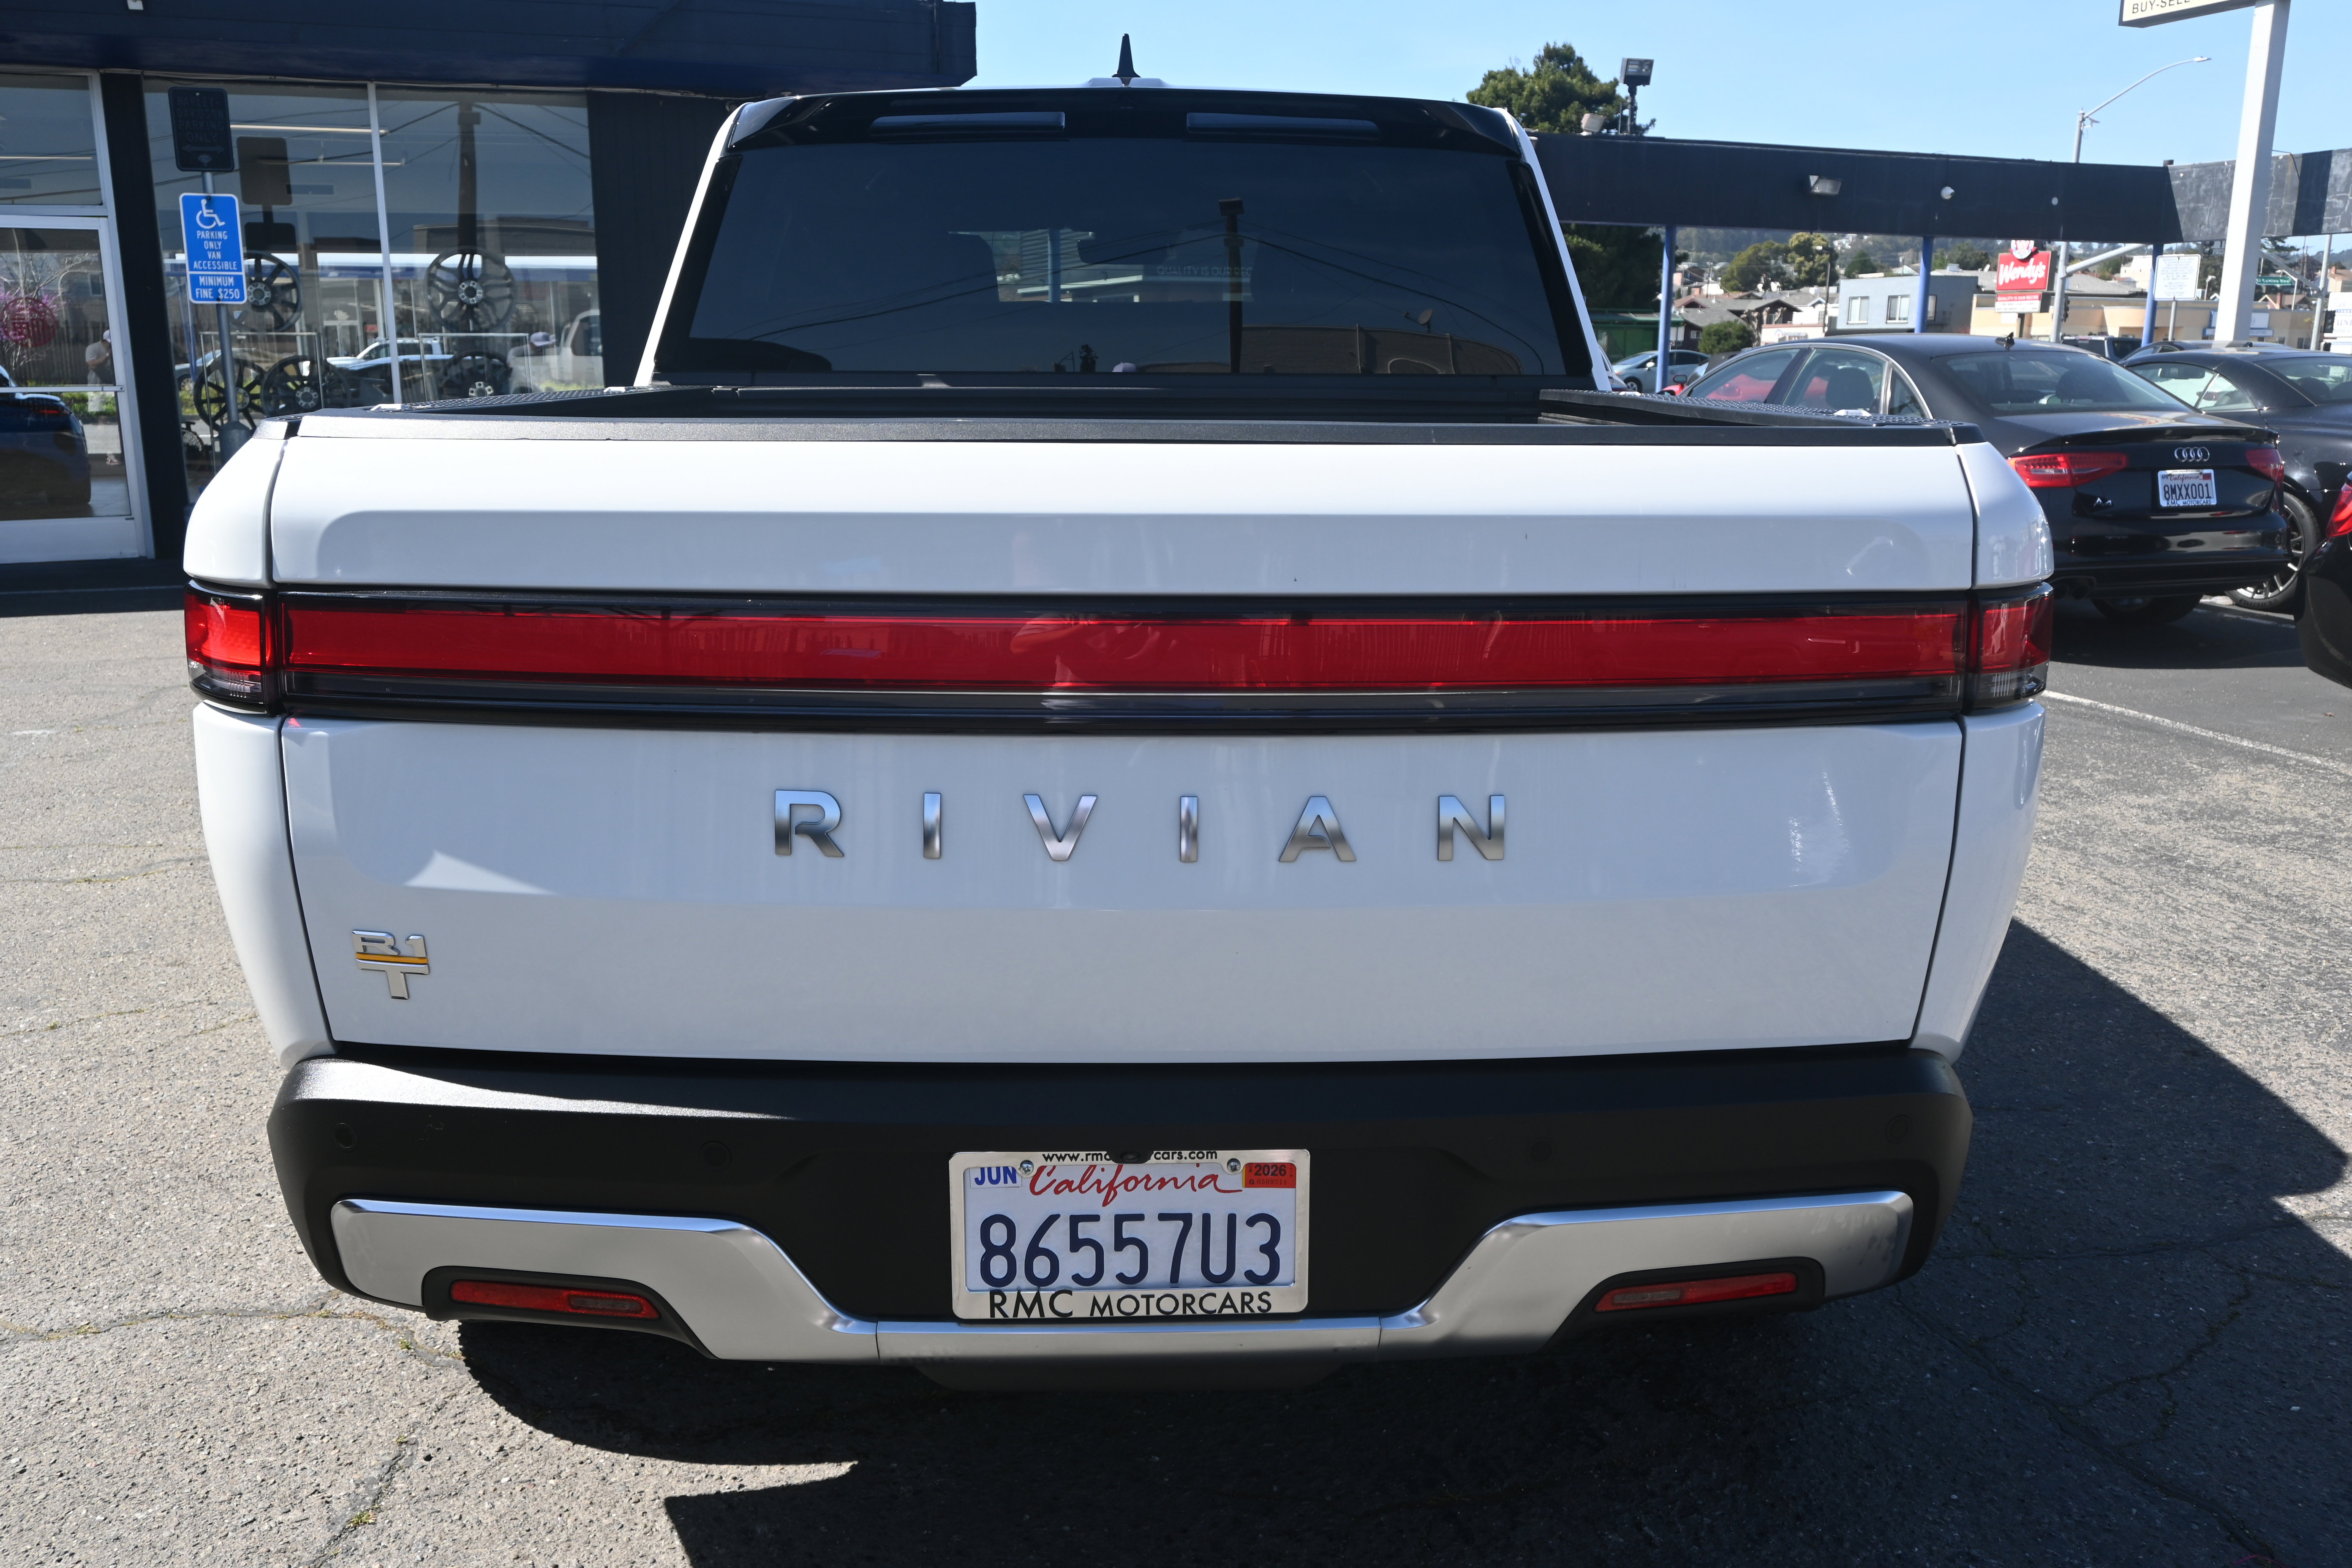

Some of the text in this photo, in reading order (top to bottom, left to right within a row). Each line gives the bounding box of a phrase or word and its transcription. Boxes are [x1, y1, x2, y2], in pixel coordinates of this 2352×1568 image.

[2132, 0, 2190, 14] BUY-SE
[177, 109, 225, 119] DAVIDSON
[179, 120, 224, 131] PARKING
[186, 132, 217, 142] ONLY
[197, 230, 228, 240] PARKING
[204, 240, 222, 250] ONLY
[207, 251, 221, 260] VAN
[193, 261, 237, 270] ACCESSIBLE
[1157, 266, 1253, 276] QUALITY IS OUR REC
[1998, 258, 2046, 286] Wendy's
[199, 276, 234, 286] MINIMUM
[196, 288, 240, 299] FINE $250
[2170, 474, 2202, 483] California
[2164, 483, 2212, 500] 8MXX001
[774, 789, 1506, 863] RIVIAN
[1042, 1151, 1217, 1162] www.rmccars.com
[1255, 1164, 1287, 1176] 2026
[975, 1163, 1242, 1207] JUN California
[980, 1213, 1281, 1288] 86557U3
[990, 1289, 1272, 1318] RMC MOTORCARS
